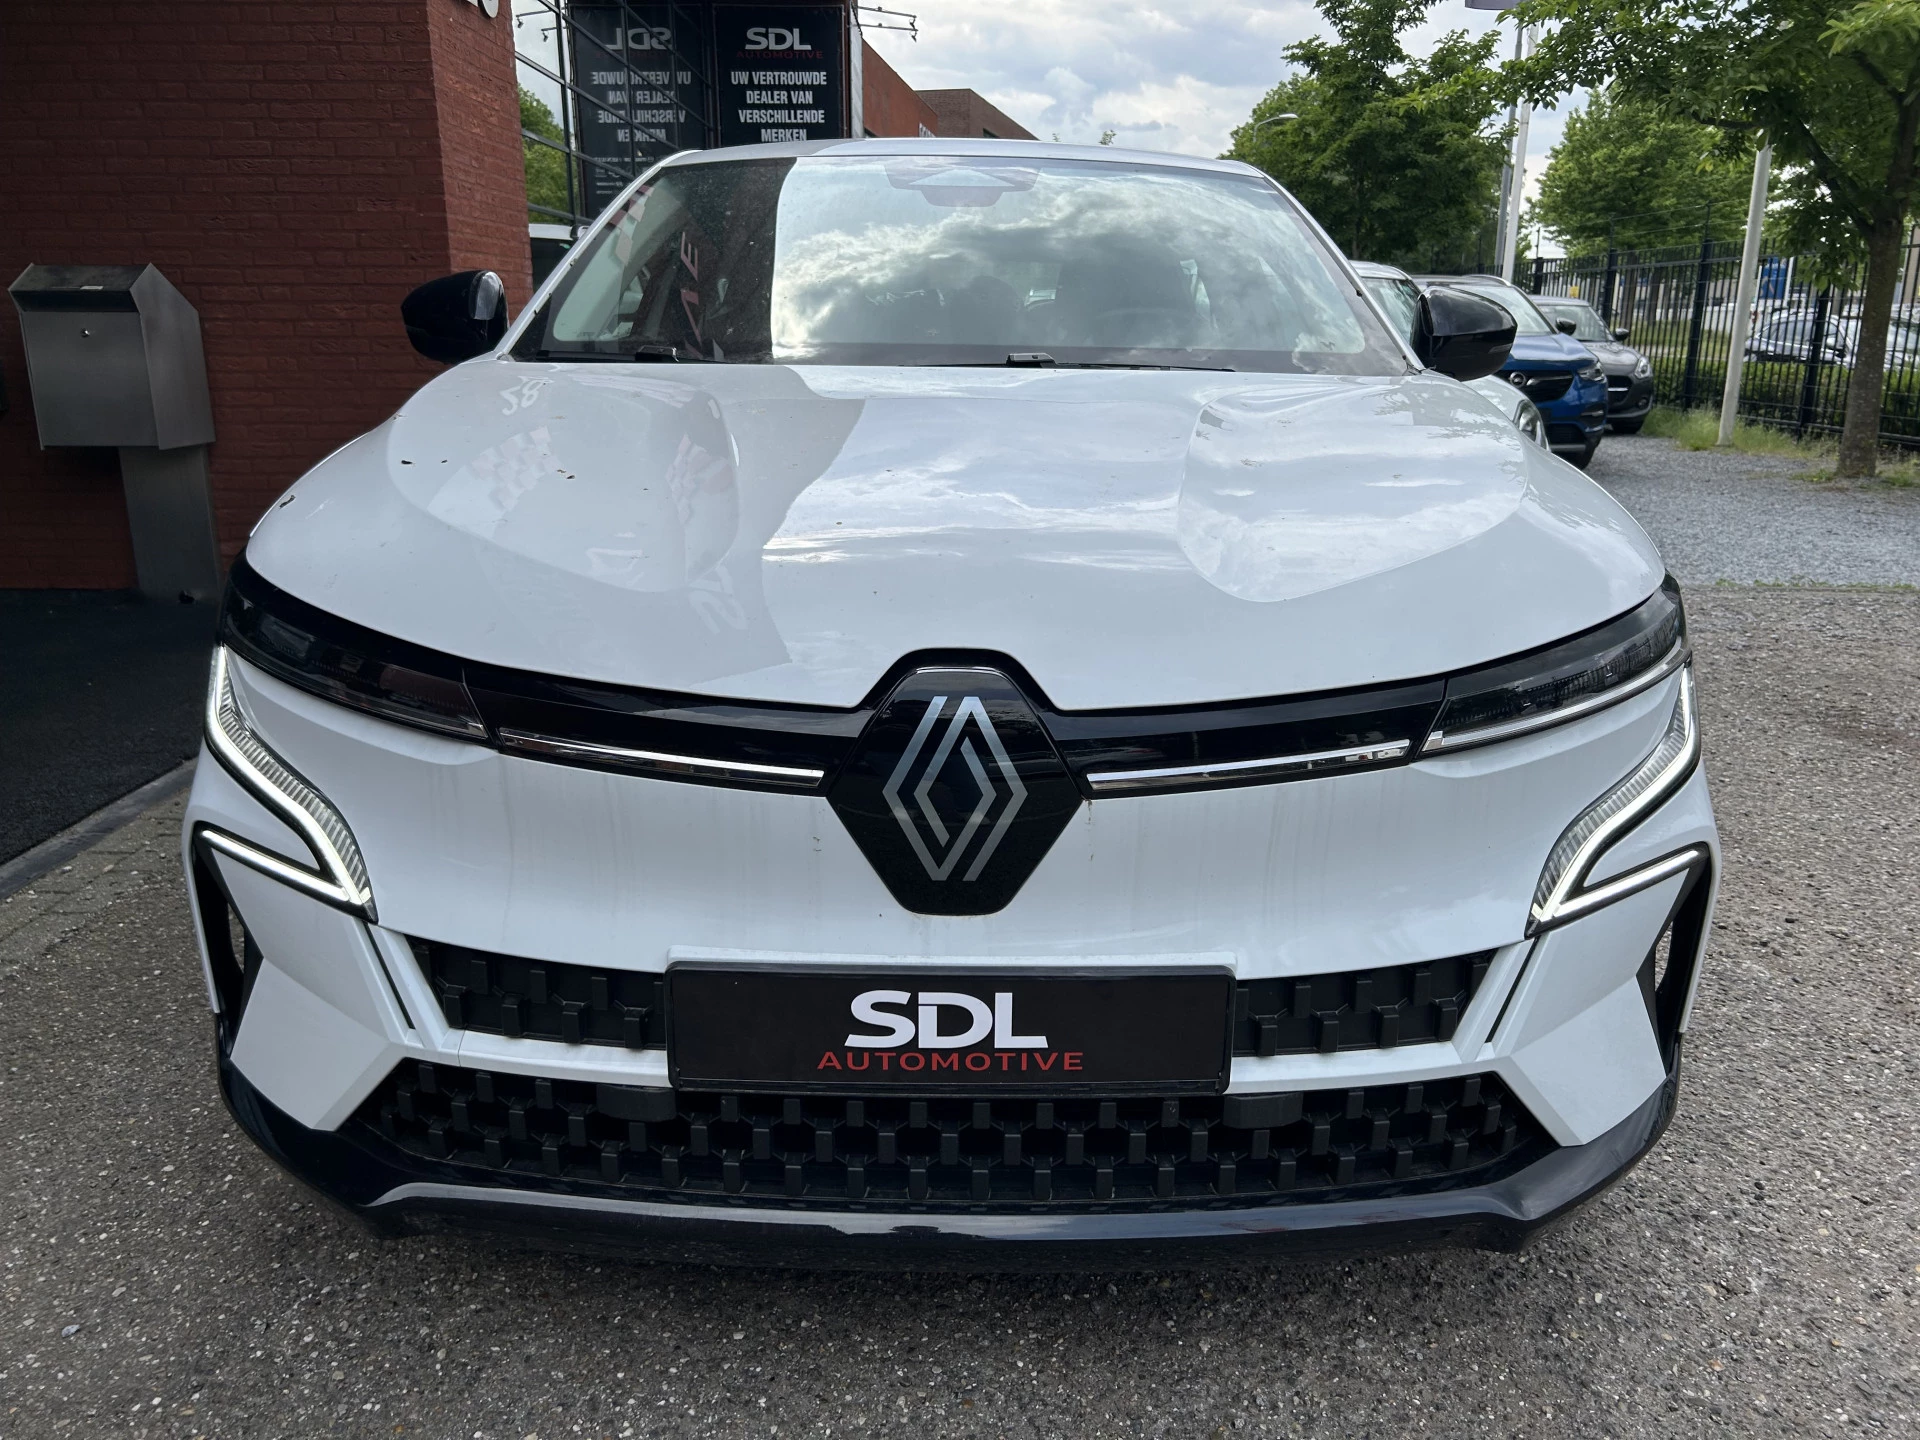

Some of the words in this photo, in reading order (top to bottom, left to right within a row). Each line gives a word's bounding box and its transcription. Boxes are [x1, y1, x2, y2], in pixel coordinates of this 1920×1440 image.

[745, 27, 812, 50] SDL
[736, 51, 824, 59] AUTOMOTIVE
[731, 71, 749, 85] UW
[752, 71, 827, 85] VERTROUWDE
[746, 90, 788, 104] DEALER
[790, 90, 813, 104] VAN
[738, 109, 825, 123] VERSCHILLENDE
[760, 128, 807, 142] MERKEN
[844, 989, 1049, 1049] SDL
[817, 1051, 1084, 1072] AUTOMOTIVE
